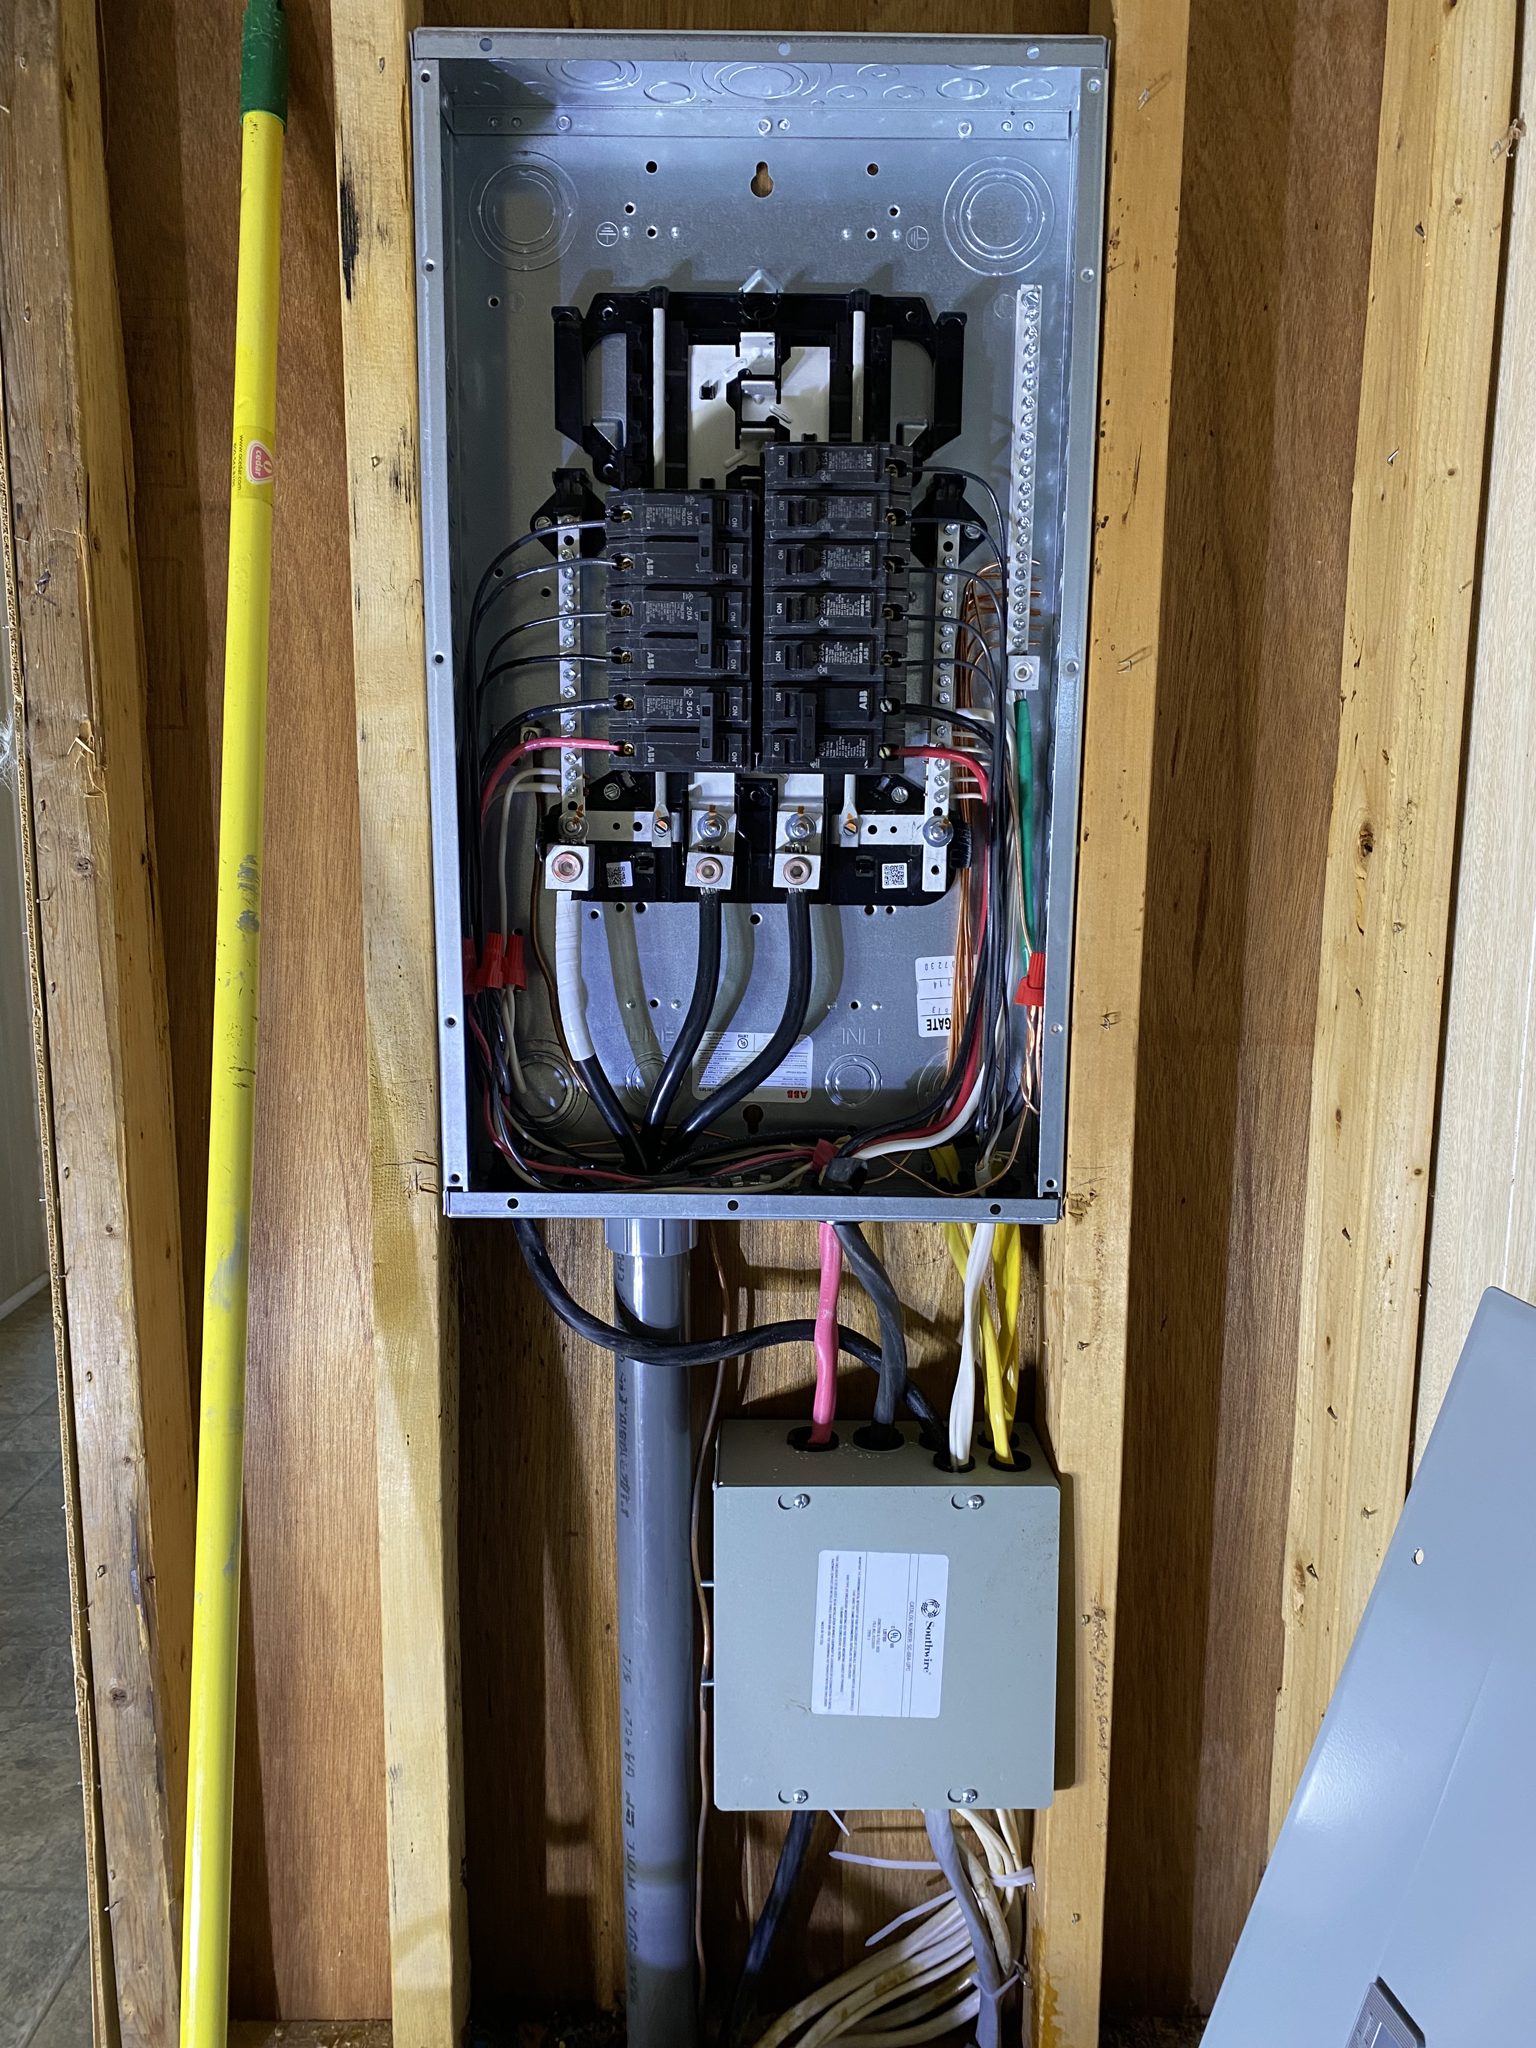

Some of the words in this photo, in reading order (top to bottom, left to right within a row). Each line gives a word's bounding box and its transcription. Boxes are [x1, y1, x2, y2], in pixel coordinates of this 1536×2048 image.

[255, 450, 263, 476] cedar
[778, 454, 785, 466] ON
[778, 500, 785, 511] ON
[731, 517, 738, 528] ON
[777, 549, 784, 560] ON
[646, 557, 654, 576] ABB
[731, 563, 738, 575] ON
[776, 602, 783, 614] ON
[730, 611, 737, 622] ON
[646, 651, 655, 670] ABB
[775, 650, 782, 662] ON
[730, 658, 737, 670] ON
[775, 692, 782, 702] ON
[859, 690, 868, 710] ABB
[731, 705, 738, 717] ON
[773, 742, 780, 752] ON
[647, 745, 655, 764] ABB
[731, 751, 738, 763] ON
[926, 1017, 951, 1031] GATE
[786, 1090, 808, 1099] ABB
[923, 1621, 935, 1673] Southwire
